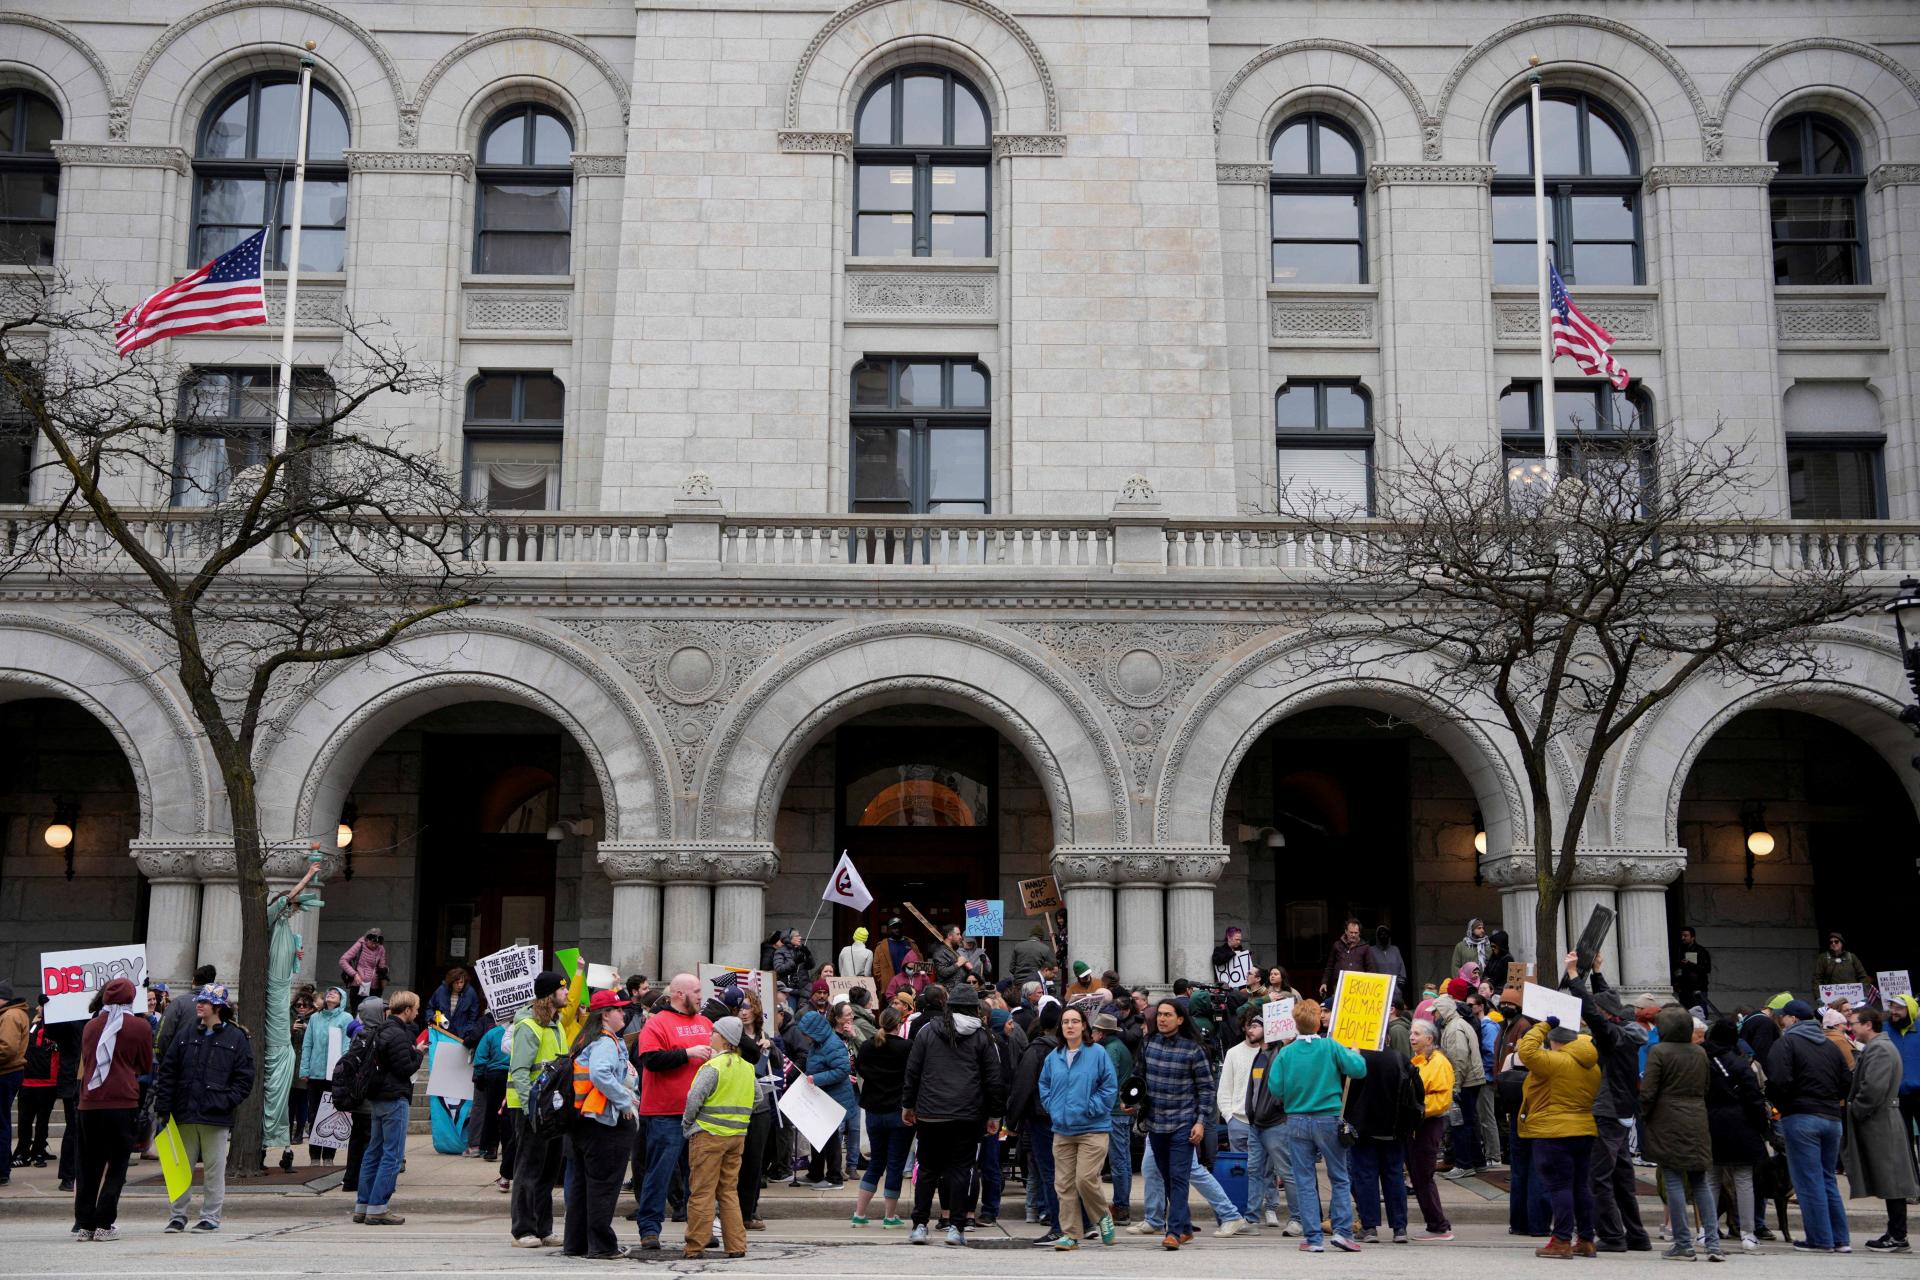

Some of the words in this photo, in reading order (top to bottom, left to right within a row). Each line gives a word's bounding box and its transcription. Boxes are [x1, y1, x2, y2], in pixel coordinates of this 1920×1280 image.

[1024, 879, 1048, 890] HANDS
[1030, 887, 1044, 899] OFF
[1028, 897, 1057, 909] JUDGES
[487, 958, 501, 969] THE
[501, 951, 526, 965] PEOPLE
[488, 965, 505, 976] WILL
[504, 959, 528, 972] DEFEAT
[490, 966, 529, 985] TRUMP'S
[830, 980, 853, 989] THIS
[857, 979, 867, 989] IS
[494, 982, 533, 998] EXTREME-RIGHT
[1349, 979, 1383, 998] BRING
[496, 989, 534, 1008] AGENDA!
[1343, 996, 1383, 1016] KILMAR
[1267, 1003, 1281, 1018] ICE
[1337, 1017, 1377, 1042] HOME
